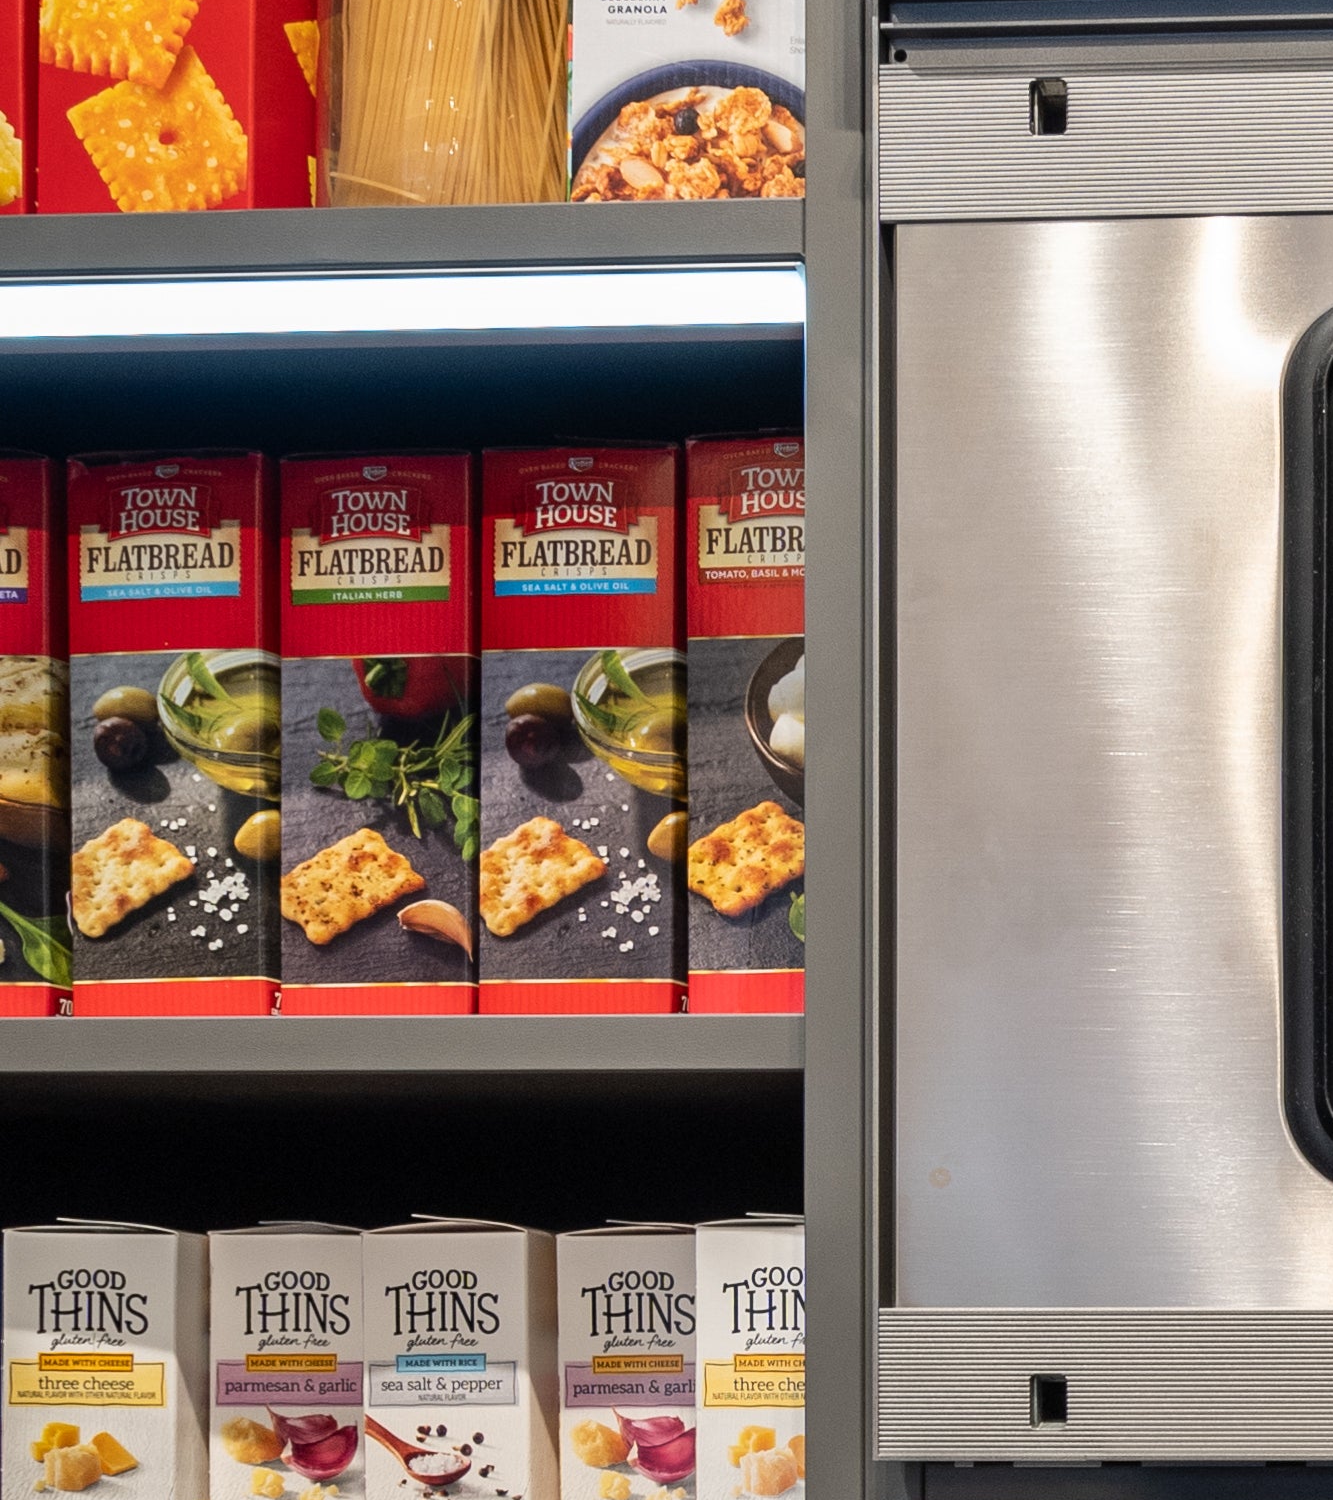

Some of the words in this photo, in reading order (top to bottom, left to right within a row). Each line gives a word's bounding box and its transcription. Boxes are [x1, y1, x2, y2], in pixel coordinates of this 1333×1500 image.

[608, 6, 667, 14] GRANOLA
[121, 487, 197, 510] TOWN
[331, 490, 408, 513] TOWN
[536, 481, 614, 504] TOWN
[120, 509, 199, 534] HOUSE
[331, 513, 410, 537] HOUSE
[536, 504, 616, 528] HOUSE
[87, 542, 234, 573] FLATBREAD
[298, 547, 444, 576] FLATBREAD
[501, 539, 651, 568] FLATBREAD
[541, 567, 607, 576] CRISPS
[706, 571, 749, 579] TOMATO,
[333, 592, 372, 600] ITALIAN
[376, 591, 402, 599] HERB
[580, 582, 609, 590] OLIVE
[57, 1269, 126, 1290] GOOD
[264, 1271, 330, 1291] GOOD
[412, 1269, 477, 1290] GOOD
[28, 1282, 149, 1335] THINS
[236, 1283, 350, 1335] THINS
[385, 1282, 500, 1335] THINS
[406, 1334, 448, 1352] gluten
[450, 1333, 478, 1348] free
[433, 1359, 456, 1367] WITH
[38, 1377, 79, 1390] three
[83, 1377, 134, 1390] cheese
[225, 1379, 300, 1395] parmesan
[304, 1379, 315, 1392] &
[319, 1379, 357, 1395] garlic
[381, 1381, 403, 1391] sea
[407, 1377, 432, 1391] salt
[436, 1378, 446, 1391] &
[451, 1379, 502, 1392] pepper
